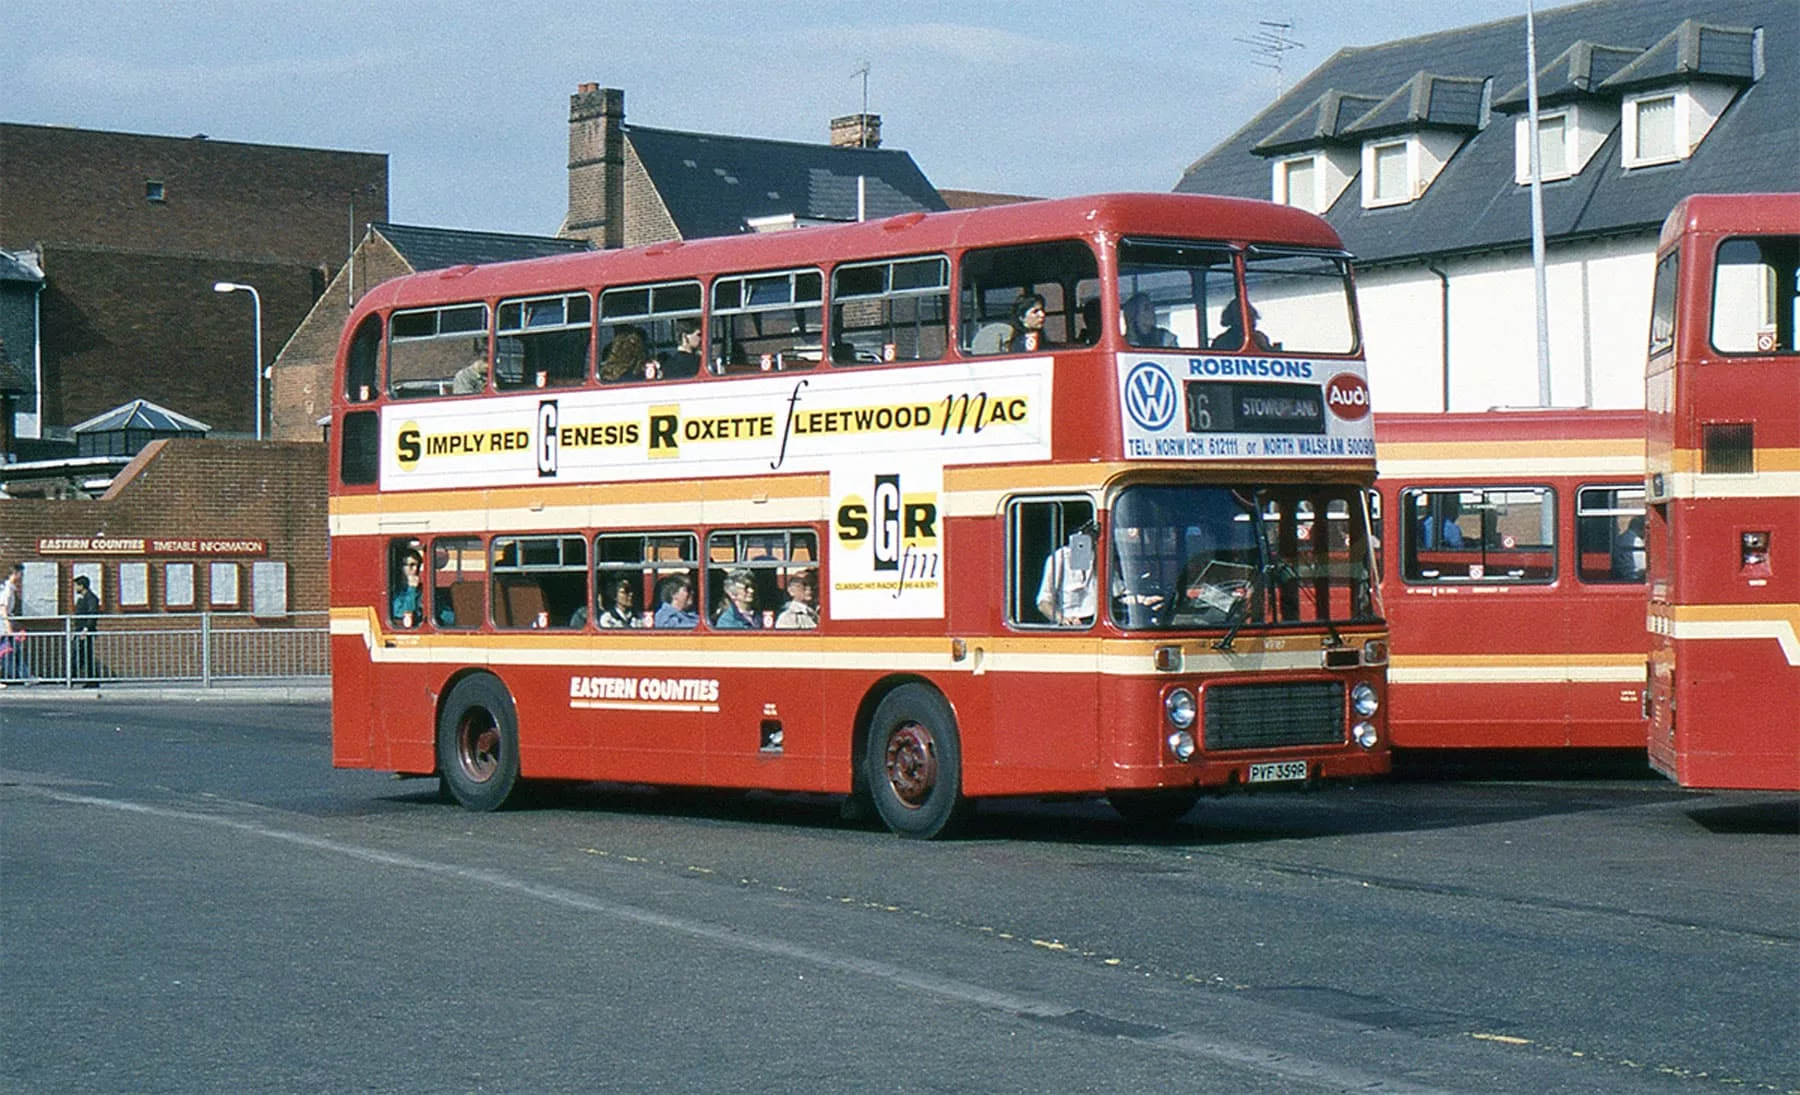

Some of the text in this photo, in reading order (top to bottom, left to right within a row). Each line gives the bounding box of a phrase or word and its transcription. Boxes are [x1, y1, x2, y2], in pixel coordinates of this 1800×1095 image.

[1189, 358, 1312, 378] ROBINSONS
[398, 430, 485, 462] SIMPLY
[490, 431, 529, 451] RED
[538, 401, 639, 476] GENESIS
[650, 415, 773, 449] ROXETTE
[1155, 439, 1204, 455] NORWICH
[1210, 437, 1238, 455] 612111
[1247, 442, 1256, 454] or
[1263, 439, 1294, 455] NORTH
[39, 539, 263, 552] EASTERN COUNTIES TIMETABLE INFORMATION
[570, 676, 719, 701] EASTERN COUNTIES
[1252, 765, 1275, 780] PVF
